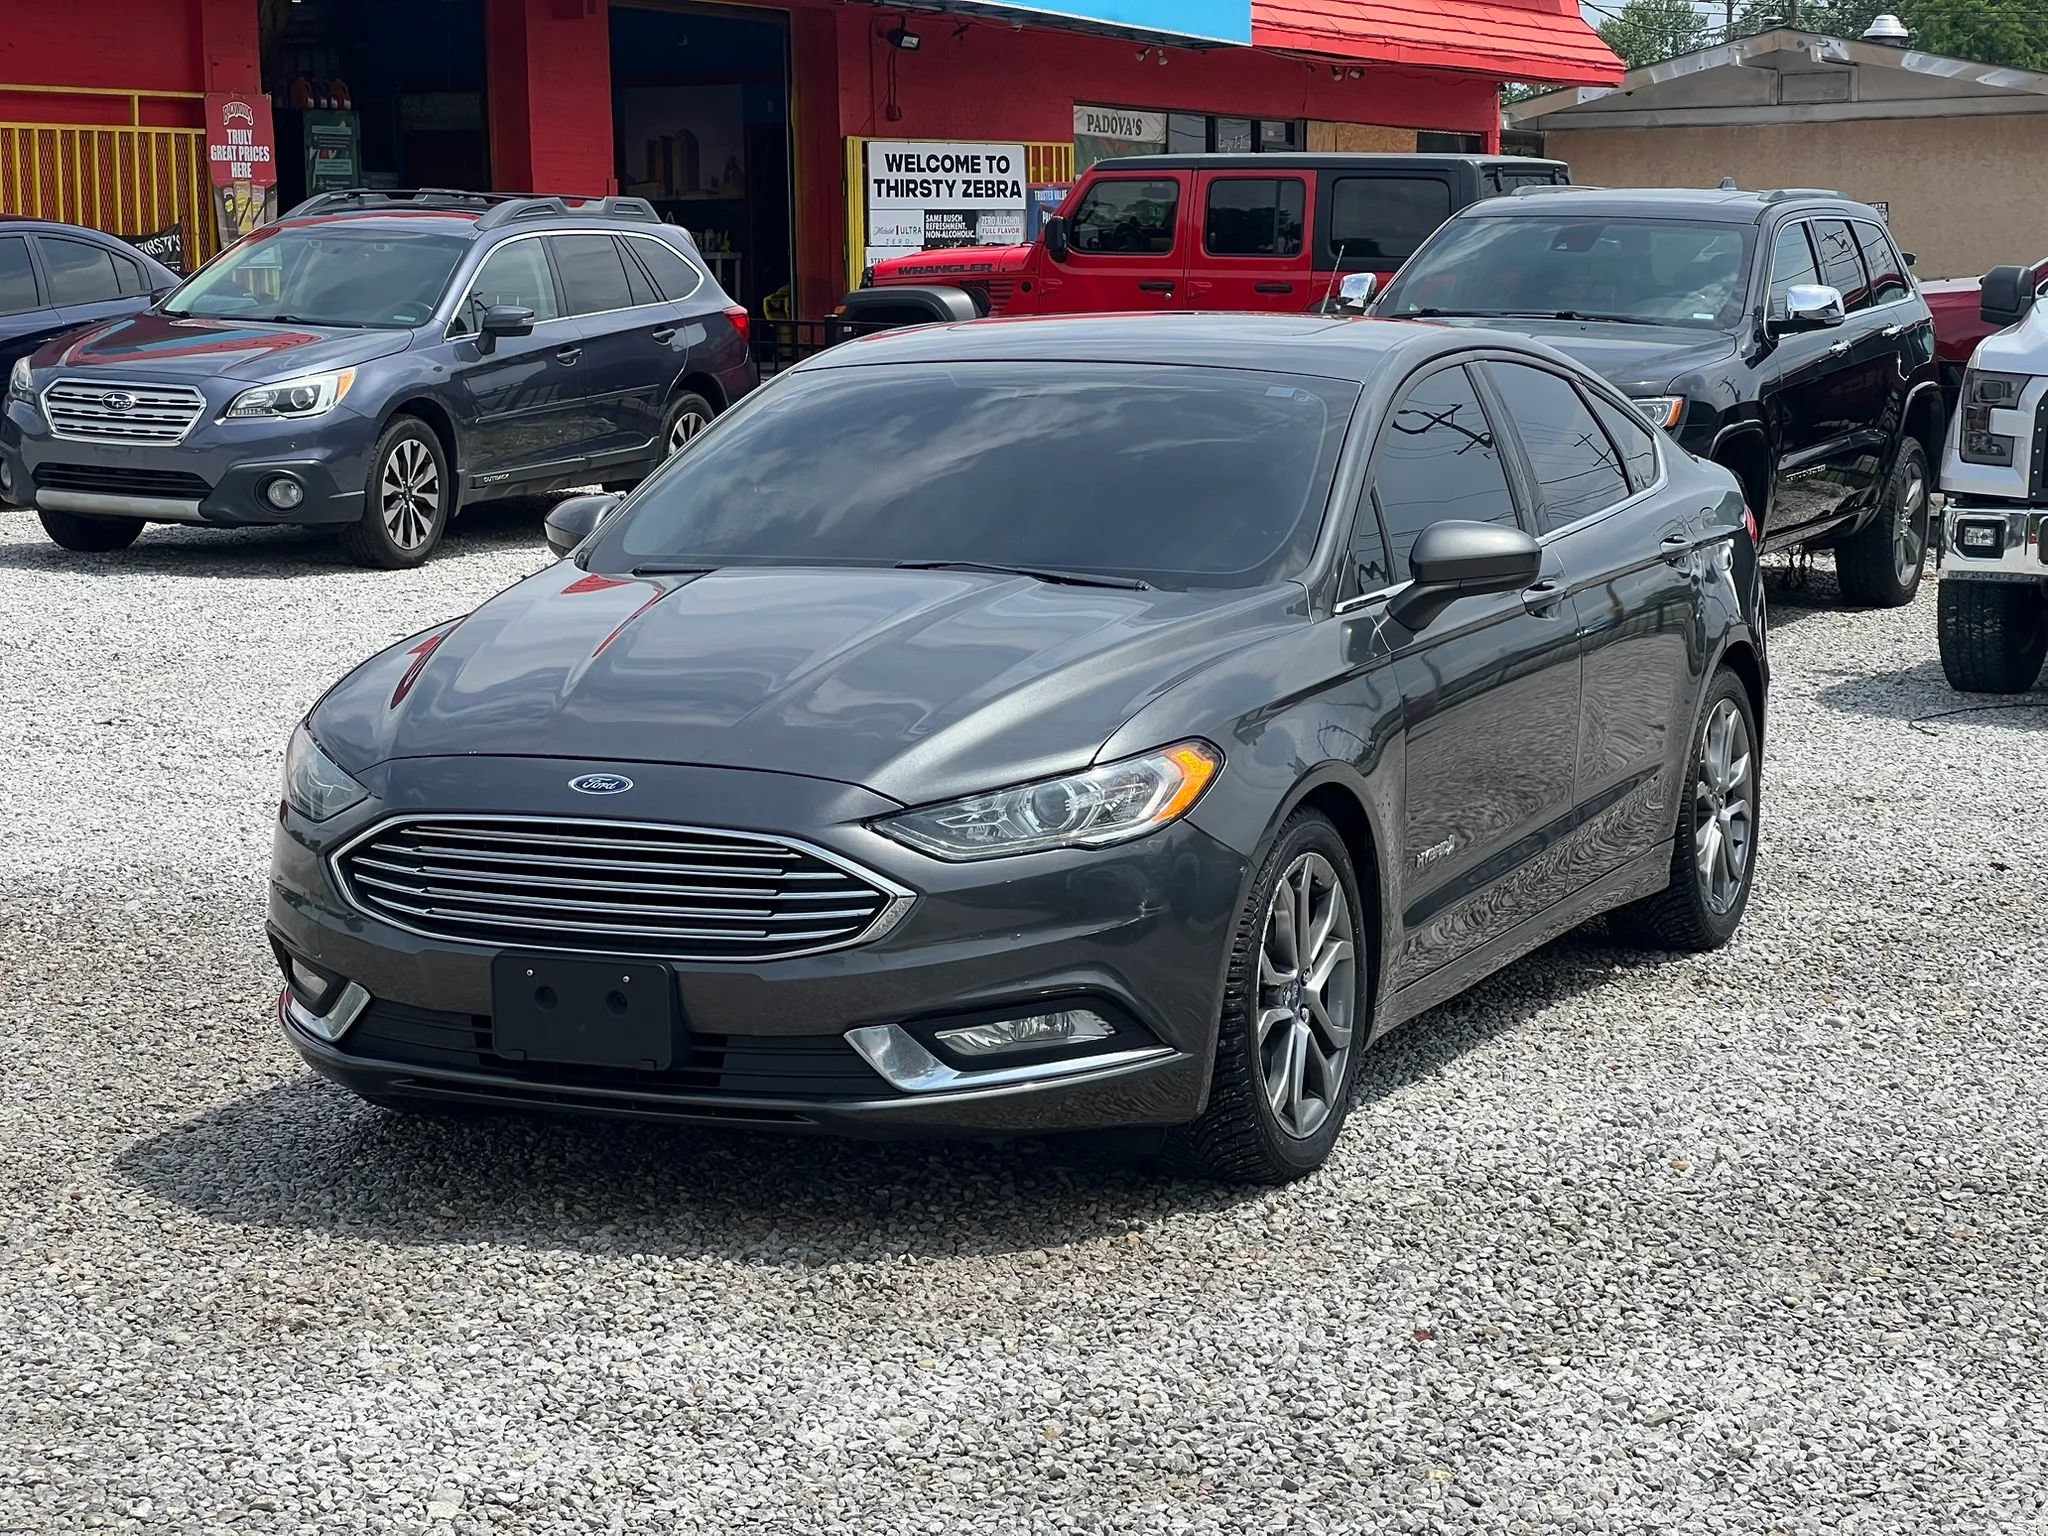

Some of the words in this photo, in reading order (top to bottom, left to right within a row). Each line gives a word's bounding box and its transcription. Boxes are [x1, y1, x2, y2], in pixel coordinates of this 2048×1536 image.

[1086, 113, 1143, 137] PADOVA'S
[226, 129, 253, 145] TRULY
[210, 144, 237, 161] GREAT
[238, 145, 270, 162] PRICES
[231, 162, 252, 178] HERE
[884, 153, 981, 174] WELCOME
[985, 155, 1010, 174] TO
[873, 178, 957, 198] THIRSTY
[961, 179, 1022, 198] ZEBRA
[925, 214, 942, 222] SAME
[943, 214, 963, 222] BUSCH
[981, 216, 996, 226] ZERO
[900, 226, 922, 235] ULTRA
[135, 234, 181, 256] IRSTY'S
[896, 263, 993, 276] WRANGLER
[582, 777, 619, 790] Ford
